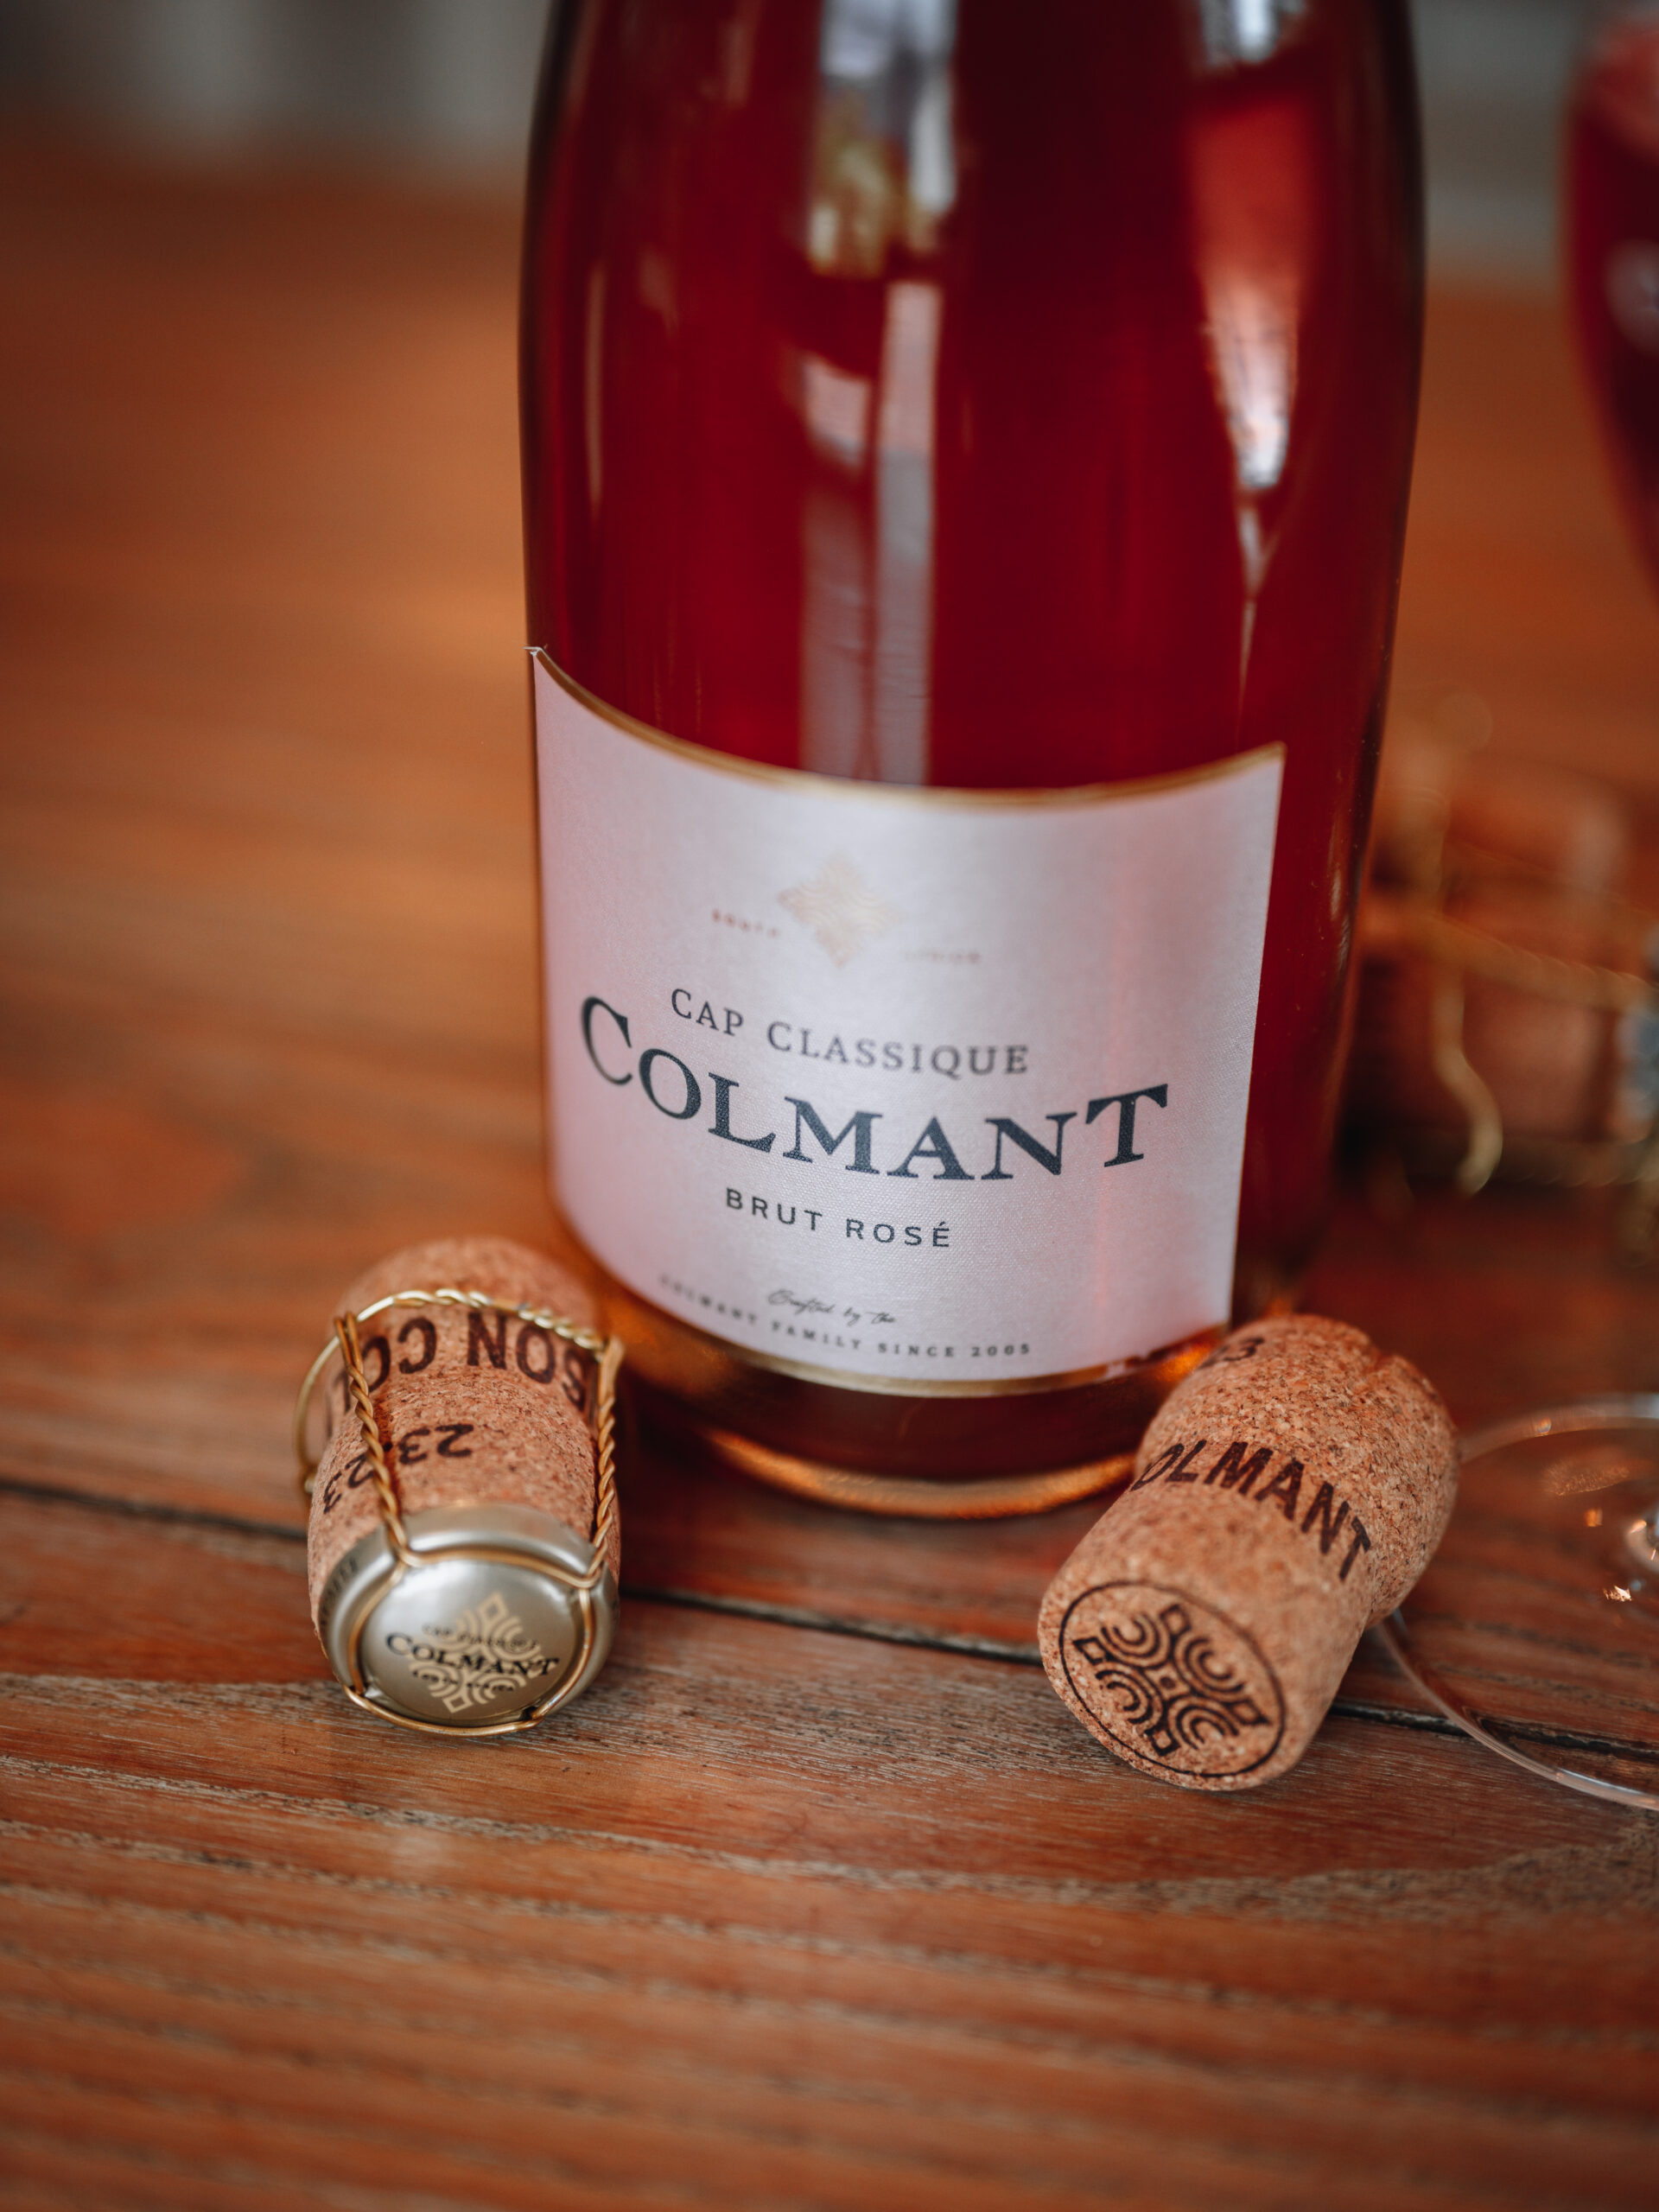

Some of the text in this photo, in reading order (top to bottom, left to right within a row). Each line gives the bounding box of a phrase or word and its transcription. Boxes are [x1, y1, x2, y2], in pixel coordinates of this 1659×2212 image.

[671, 988, 1029, 1079] CAP CLASSIQUE
[580, 995, 1169, 1181] COLMANT
[726, 1187, 950, 1249] BRUT ROSÉ
[767, 1288, 897, 1327] Crafted by the
[772, 1321, 862, 1351] FAMILY
[878, 1343, 956, 1358] SINCE
[971, 1342, 1032, 1357] 2005
[385, 1631, 560, 1676] COLMANT
